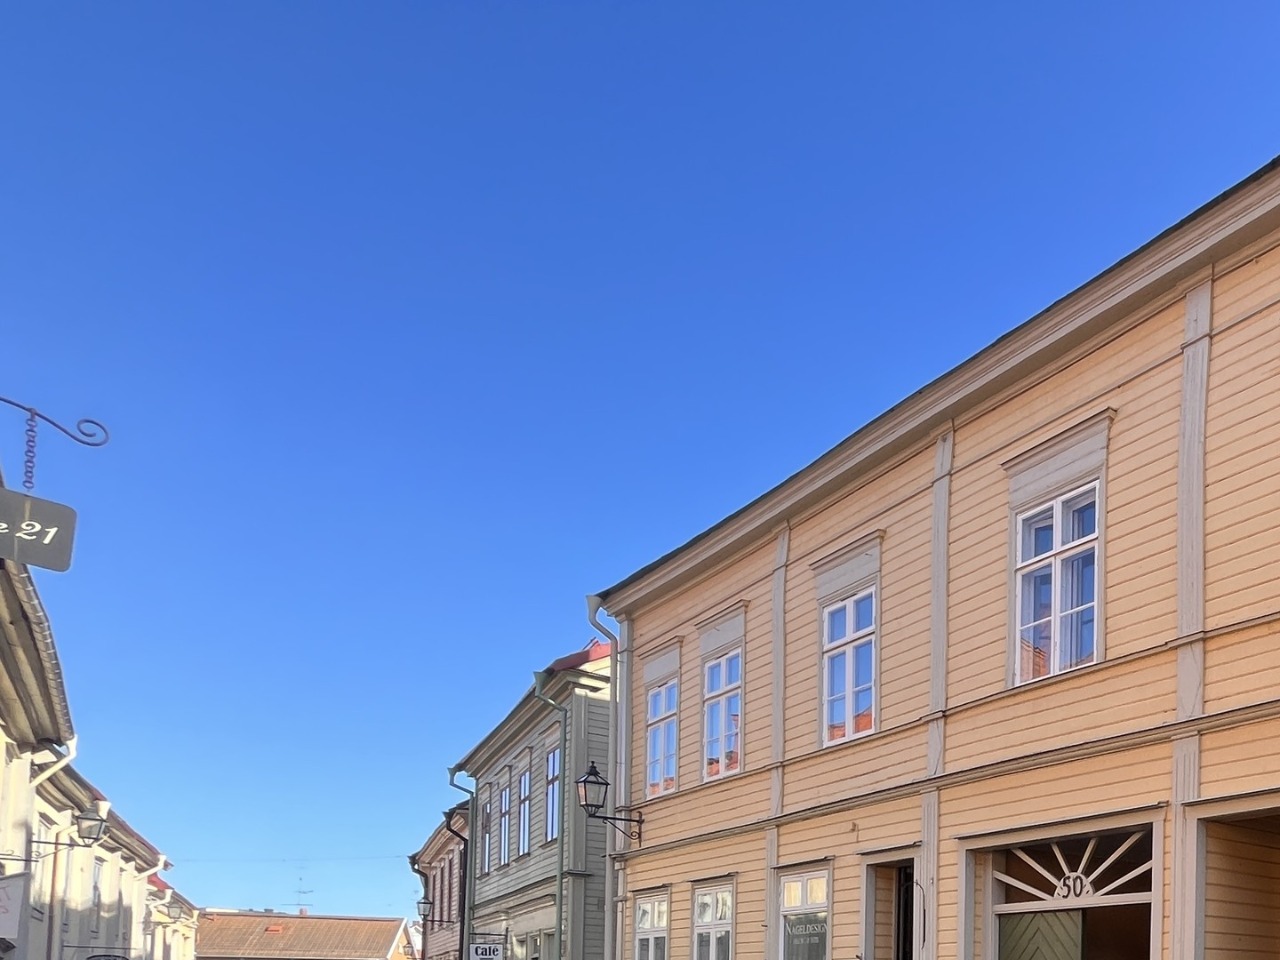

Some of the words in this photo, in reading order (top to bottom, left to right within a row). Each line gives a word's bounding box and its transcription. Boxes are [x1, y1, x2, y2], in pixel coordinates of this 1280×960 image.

[15, 520, 59, 545] 21
[1062, 875, 1083, 899] 50
[474, 944, 499, 957] Café
